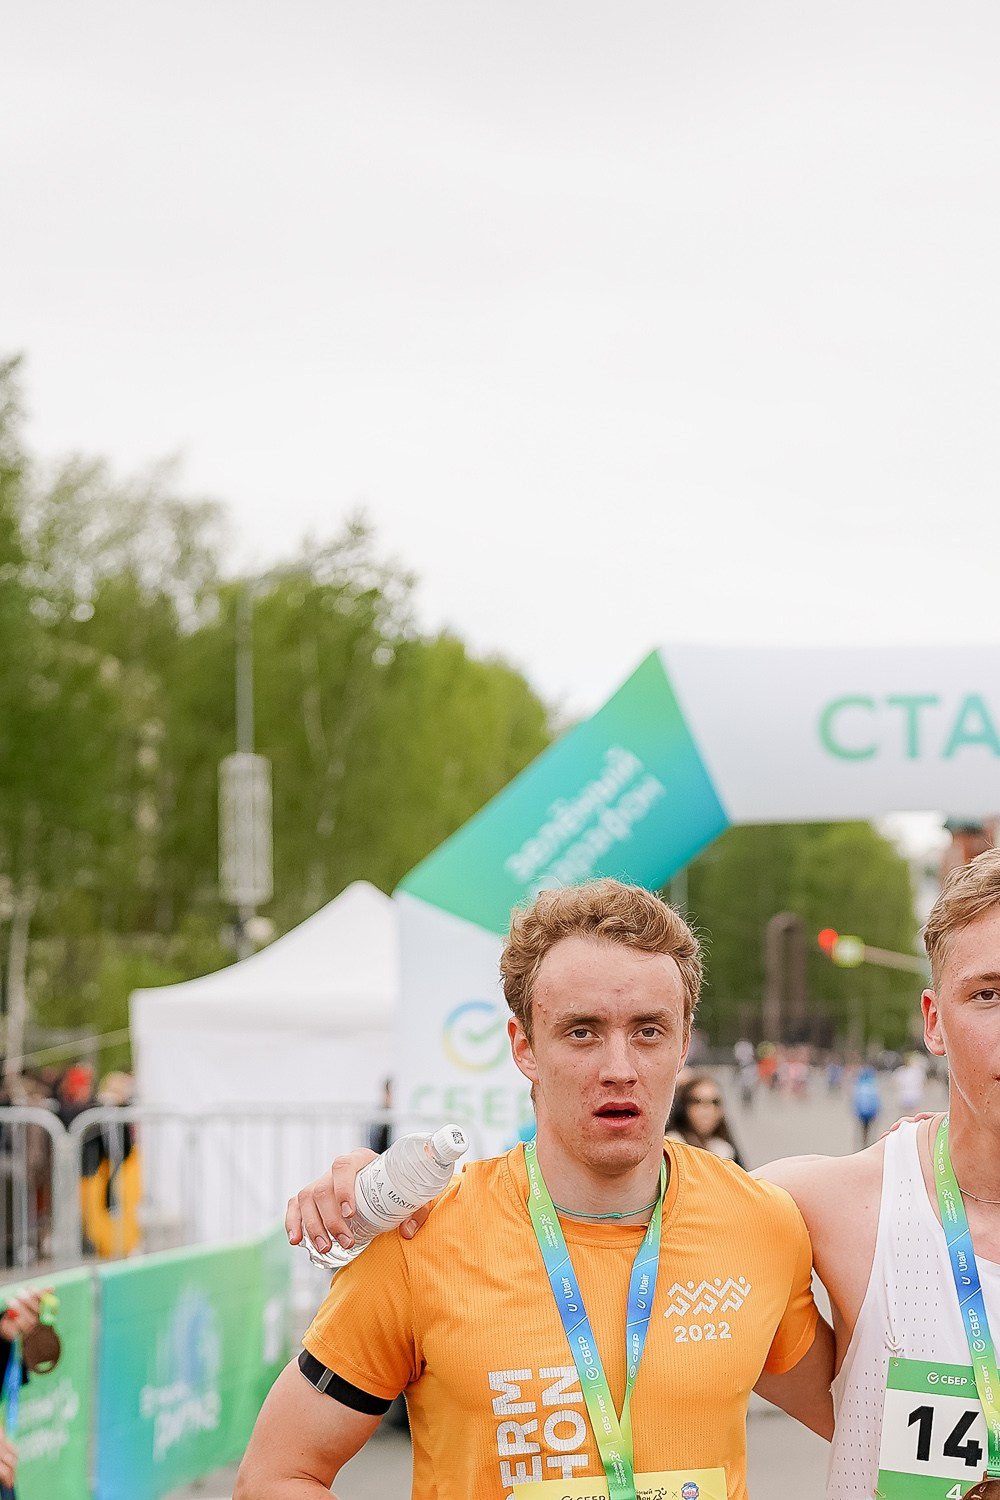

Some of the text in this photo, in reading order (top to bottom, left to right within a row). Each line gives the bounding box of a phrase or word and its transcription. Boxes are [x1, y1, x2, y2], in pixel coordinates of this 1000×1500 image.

[937, 1156, 946, 1176] 185
[956, 1250, 968, 1272] Utair
[561, 1277, 574, 1299] Utair
[638, 1273, 650, 1295] Utair
[673, 1320, 732, 1343] 2022
[967, 1308, 981, 1338] СБЕР
[577, 1336, 594, 1365] СБЕР
[632, 1333, 640, 1363] СБЕР
[940, 1375, 968, 1386] СБЕР
[981, 1364, 994, 1407] 185 лет
[596, 1393, 613, 1436] 185 лет
